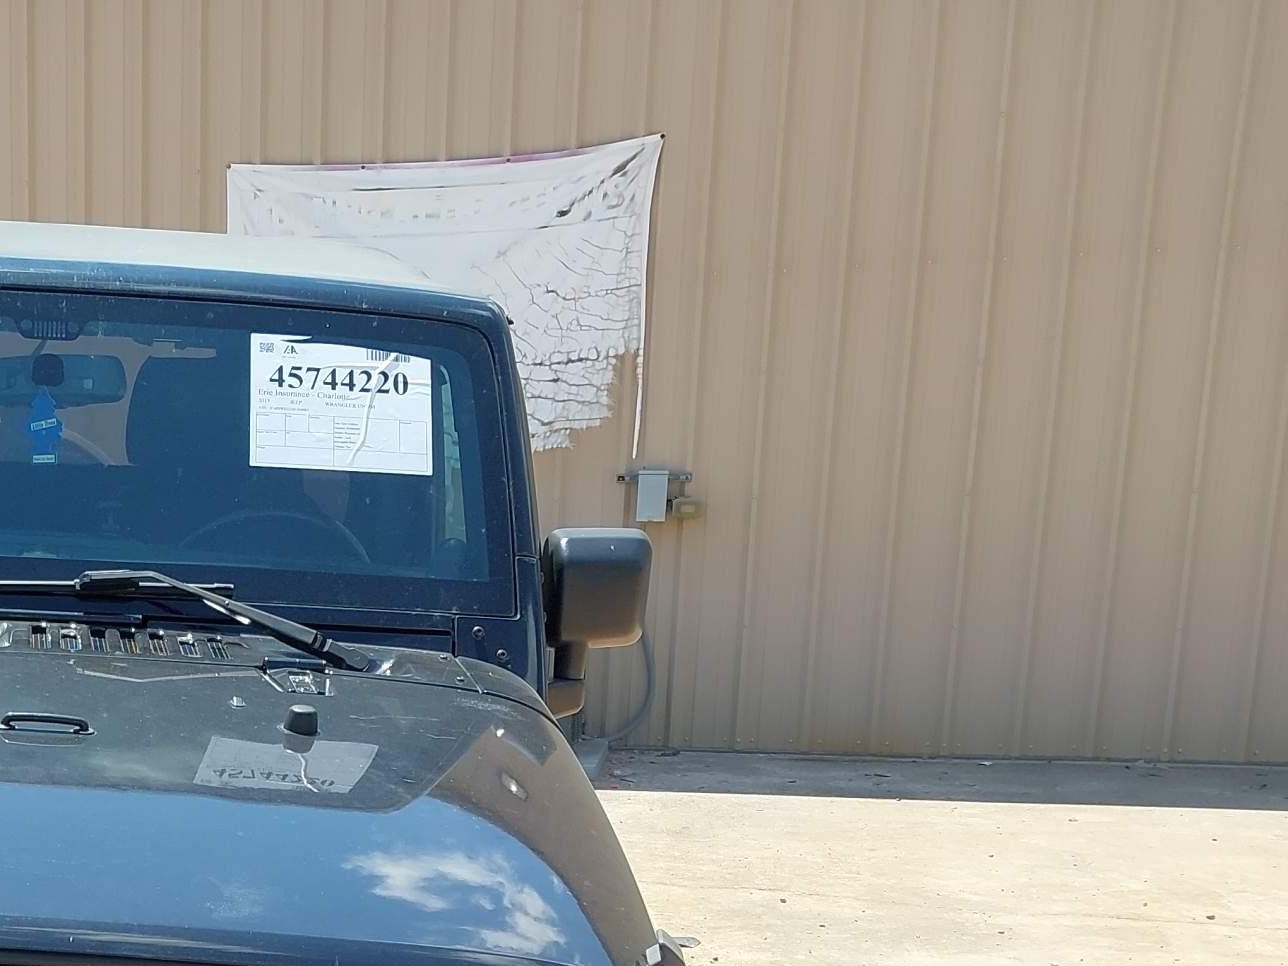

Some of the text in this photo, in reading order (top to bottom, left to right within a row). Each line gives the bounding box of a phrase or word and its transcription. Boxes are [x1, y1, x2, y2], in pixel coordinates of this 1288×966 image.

[269, 364, 409, 396] 45744220
[258, 388, 274, 396] Erie
[275, 389, 310, 398] Insurance
